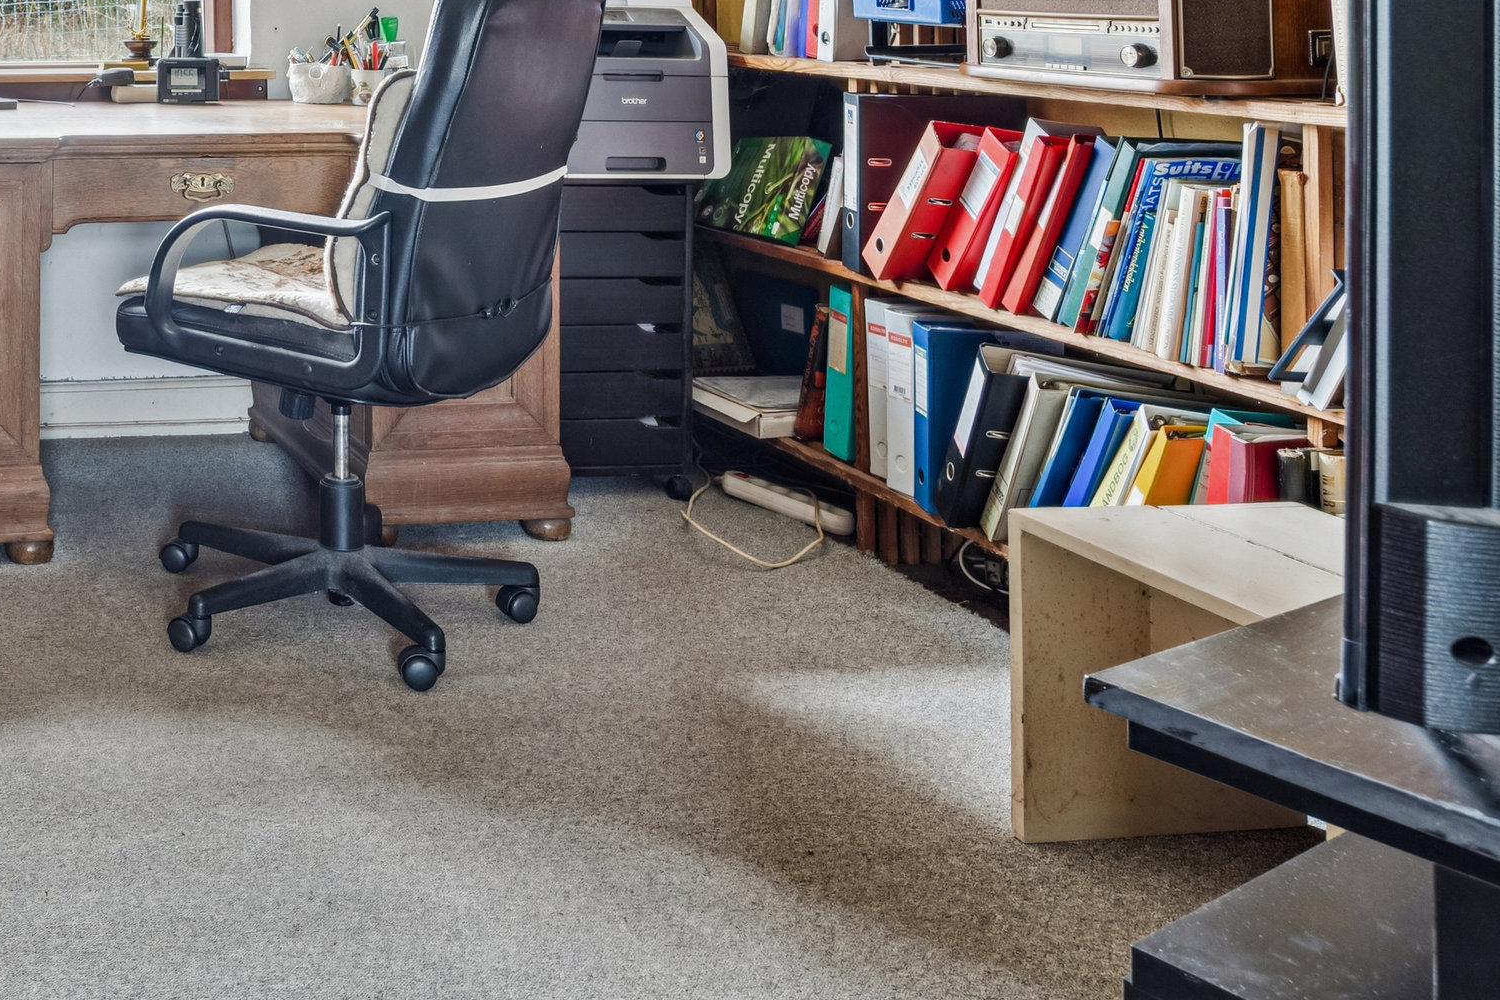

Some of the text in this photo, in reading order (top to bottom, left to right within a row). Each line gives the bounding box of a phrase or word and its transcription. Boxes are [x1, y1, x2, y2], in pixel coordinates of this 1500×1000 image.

[621, 97, 648, 105] brother
[733, 143, 776, 224] Multicopy
[788, 162, 816, 221] Multicopy
[1153, 160, 1213, 176] Suits
[1122, 221, 1150, 293] Antikvitetsleksikon
